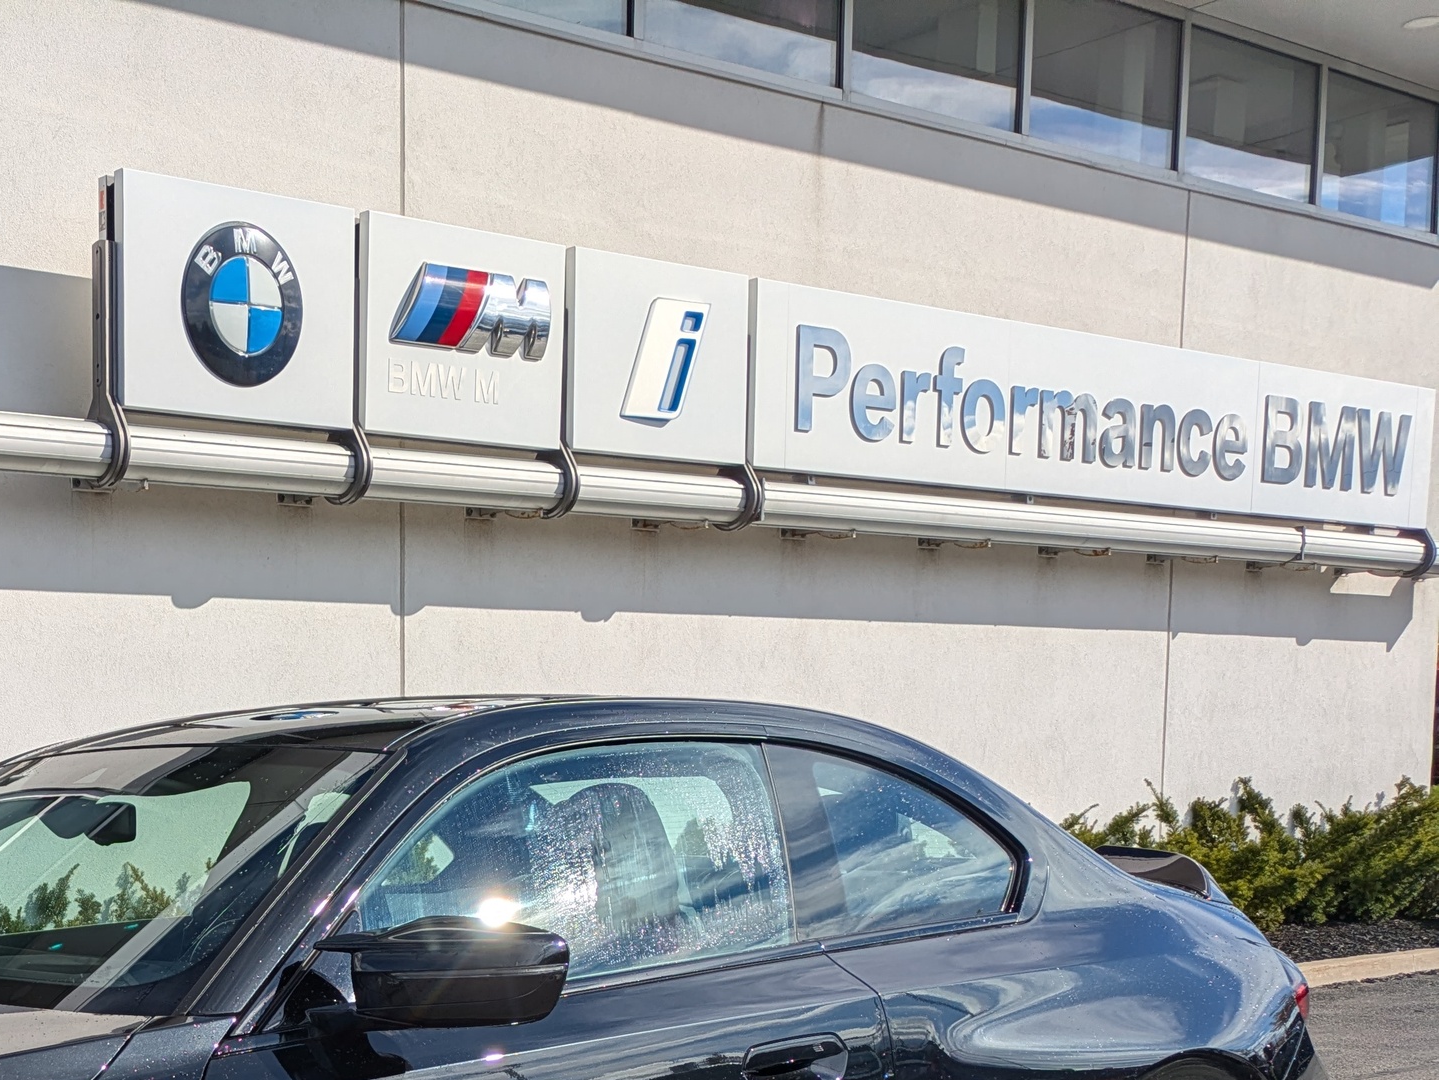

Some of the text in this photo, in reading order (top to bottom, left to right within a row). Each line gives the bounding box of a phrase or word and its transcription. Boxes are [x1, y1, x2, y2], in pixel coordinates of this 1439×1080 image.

[194, 227, 296, 286] BMW
[456, 266, 552, 362] M
[387, 357, 500, 406] BMW M
[794, 323, 1413, 497] Performance BMW
